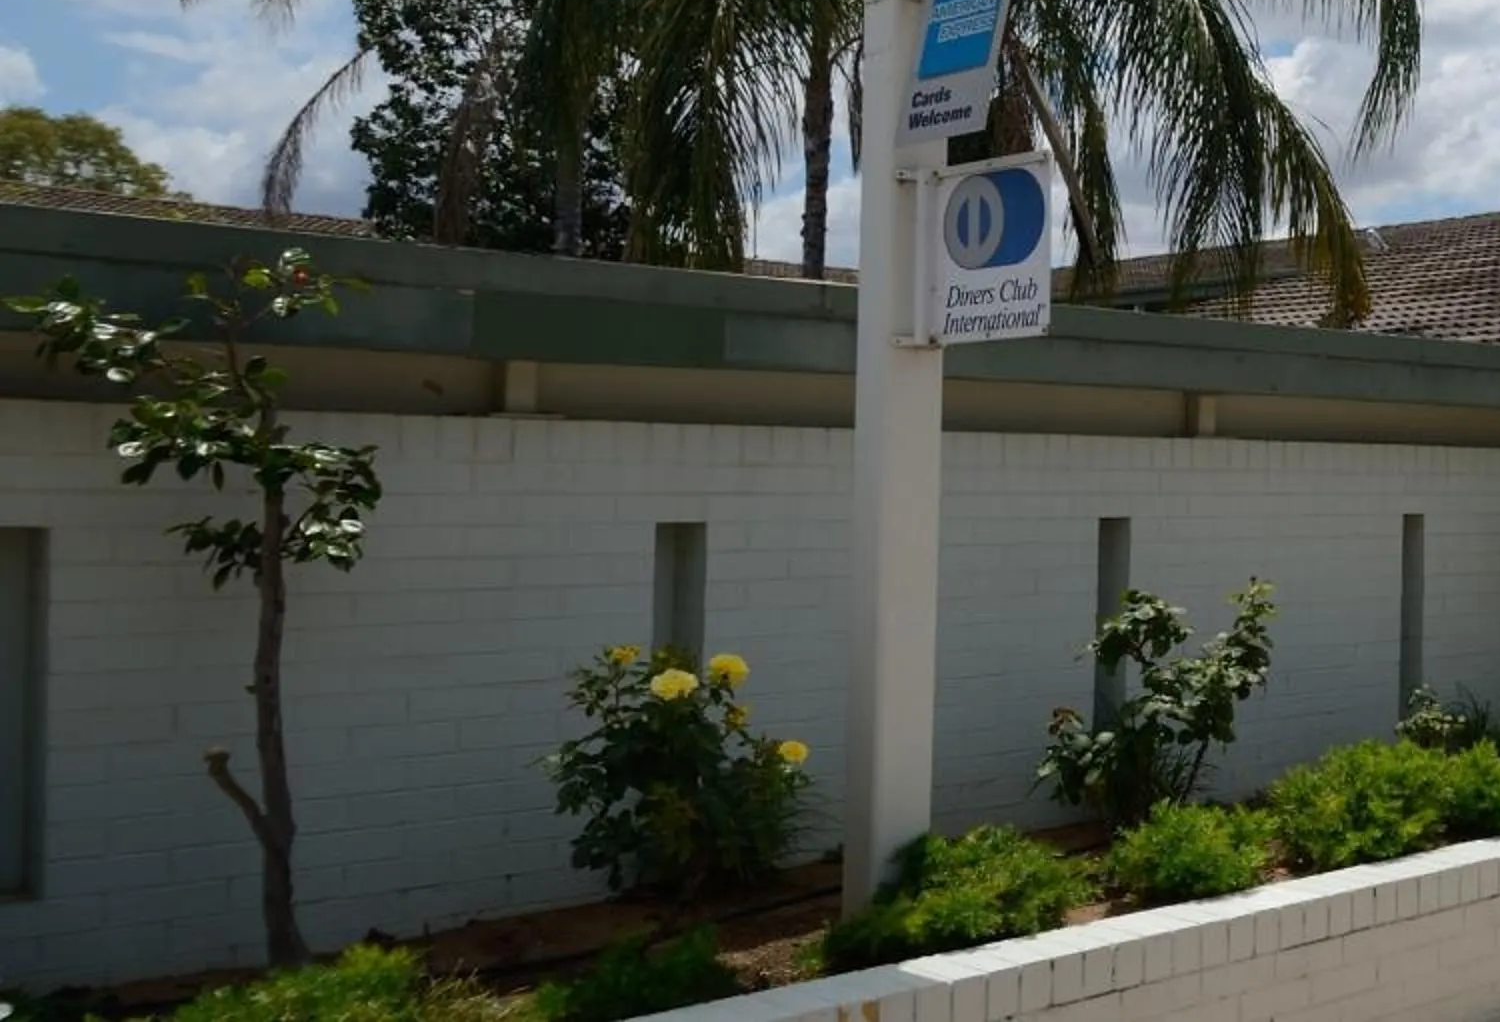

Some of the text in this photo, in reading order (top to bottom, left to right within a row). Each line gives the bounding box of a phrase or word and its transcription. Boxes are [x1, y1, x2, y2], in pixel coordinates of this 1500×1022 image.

[912, 86, 952, 109] Cards
[908, 104, 973, 131] Welcome
[946, 276, 1038, 309] Diners Club
[943, 305, 1042, 336] International
